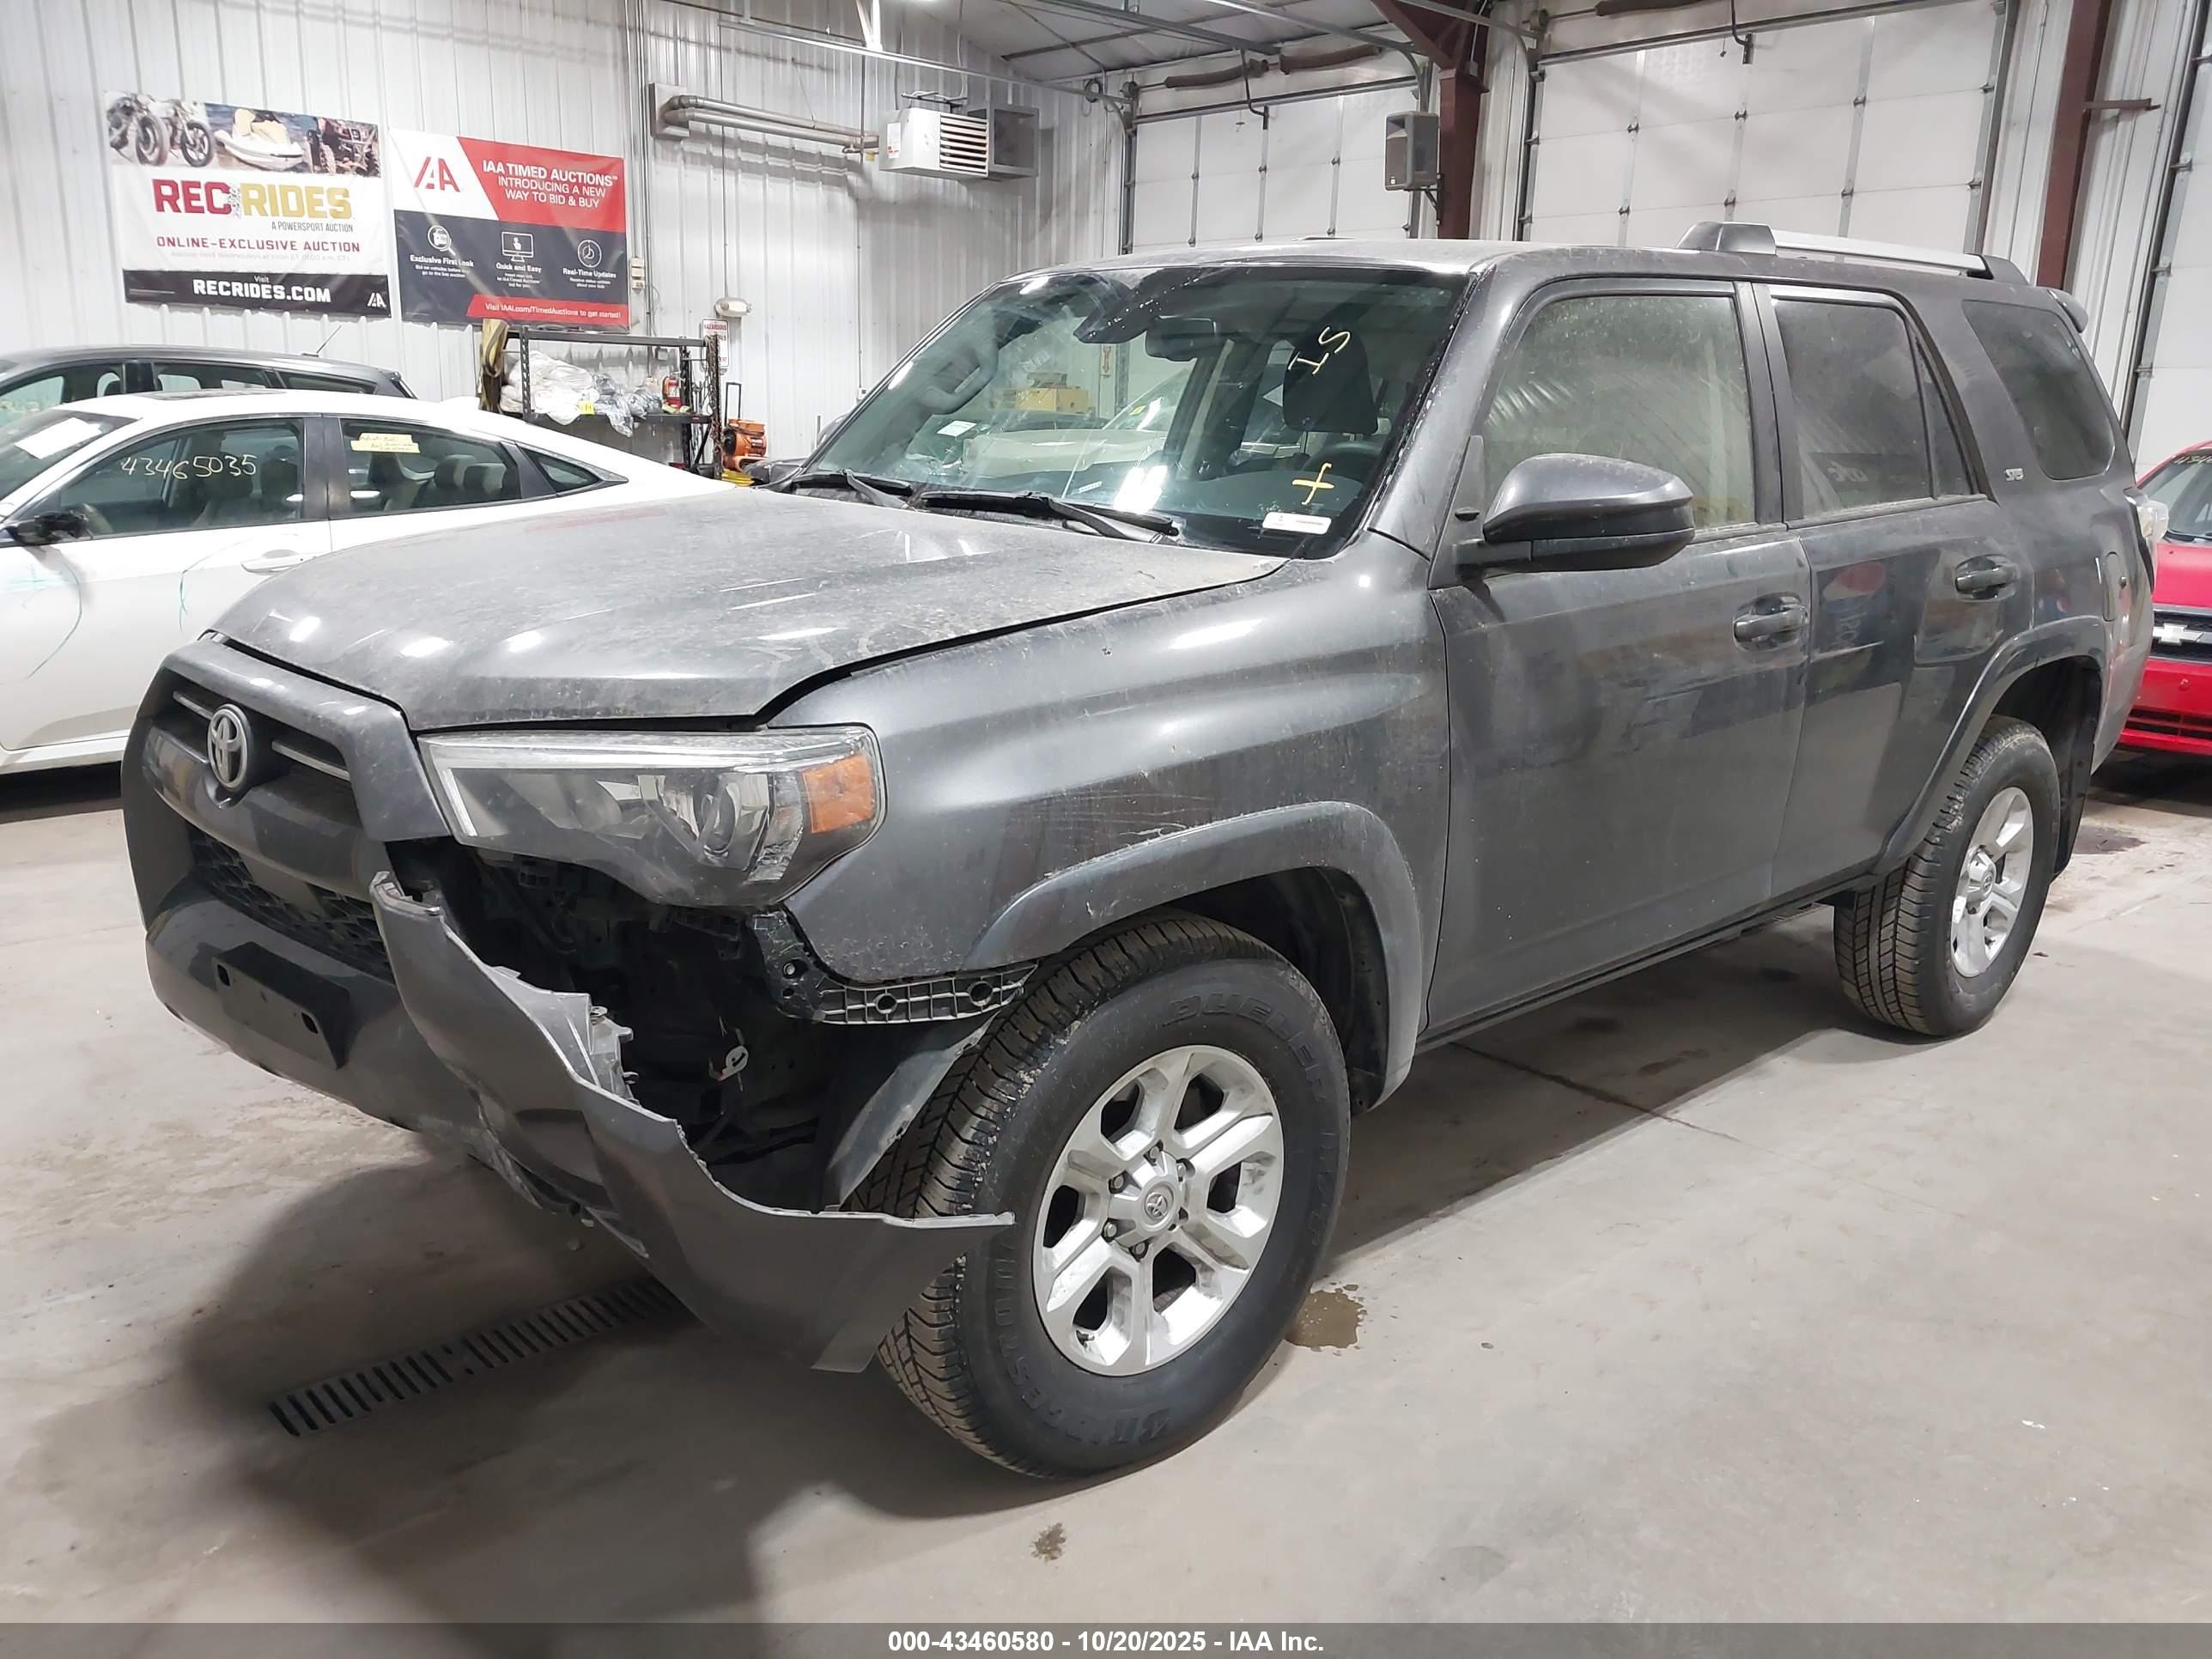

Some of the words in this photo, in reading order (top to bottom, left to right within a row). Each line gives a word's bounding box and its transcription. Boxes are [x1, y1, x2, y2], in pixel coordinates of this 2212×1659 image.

[483, 160, 505, 174] IAA
[507, 163, 547, 179] TIMED
[498, 176, 569, 193] INTRODUCING
[572, 185, 580, 194] A
[582, 186, 606, 198] NEW
[240, 183, 353, 220] RIDES
[505, 189, 530, 200] WAY
[532, 191, 547, 203] TO
[549, 194, 565, 205] BID
[568, 196, 576, 206] &
[579, 197, 600, 208] BUY
[271, 222, 276, 230] A
[325, 222, 354, 233] AUCTION
[156, 236, 298, 251] ONLINE-EXCLUSIVE
[303, 241, 361, 252] AUCTION
[410, 254, 441, 264] Exclusive
[495, 262, 513, 270] Quick
[526, 264, 542, 274] Easy
[562, 267, 592, 277] Real-Time
[593, 270, 617, 279] Updates
[192, 279, 331, 303] RECRIDES.COM
[485, 302, 500, 312] Visit
[120, 454, 258, 479] 43465035
